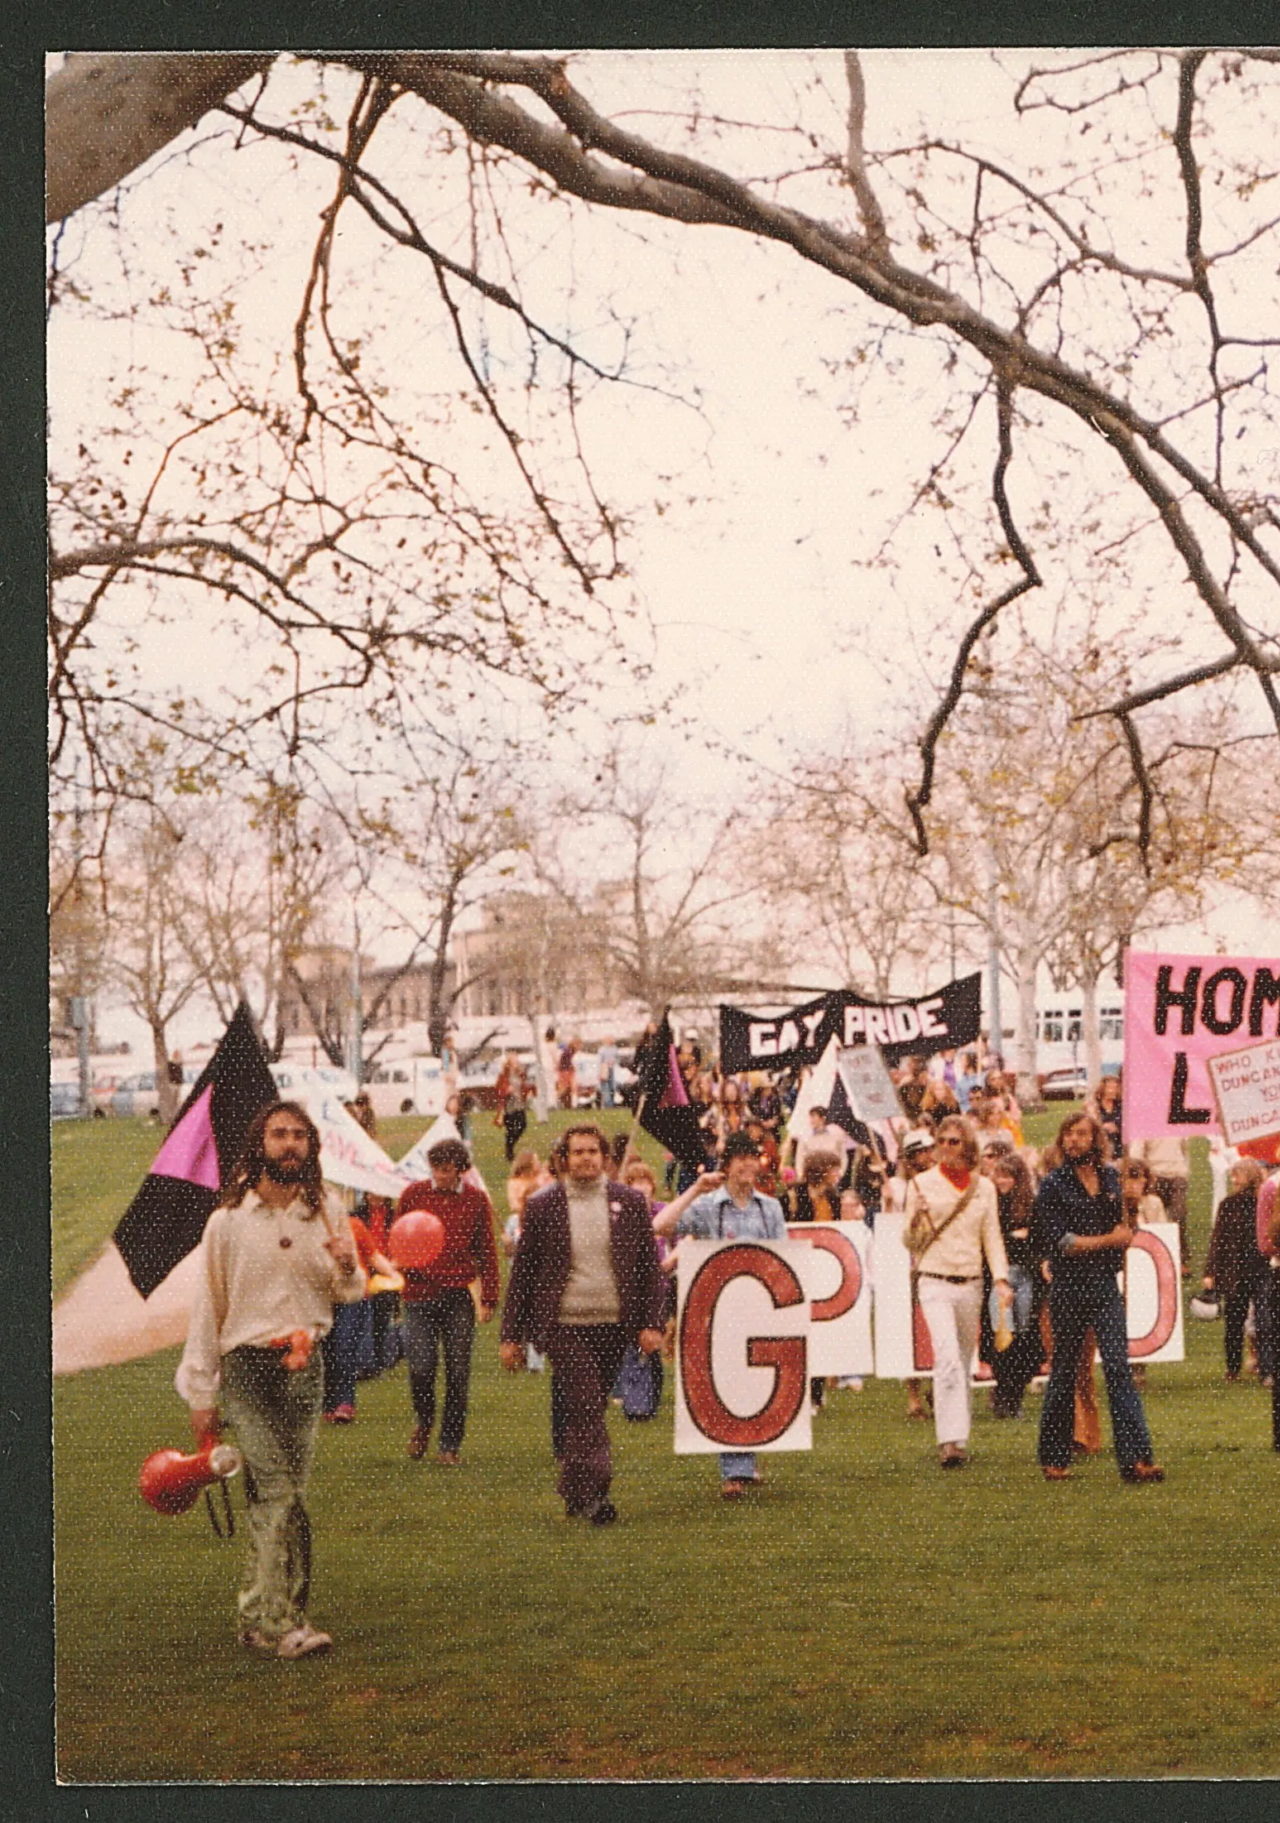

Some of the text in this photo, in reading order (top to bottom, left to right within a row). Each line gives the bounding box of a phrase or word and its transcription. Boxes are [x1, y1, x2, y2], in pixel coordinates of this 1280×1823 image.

[749, 998, 949, 1057] GAY PRIDE
[1216, 1055, 1252, 1075] WHO
[680, 1242, 807, 1447] G
